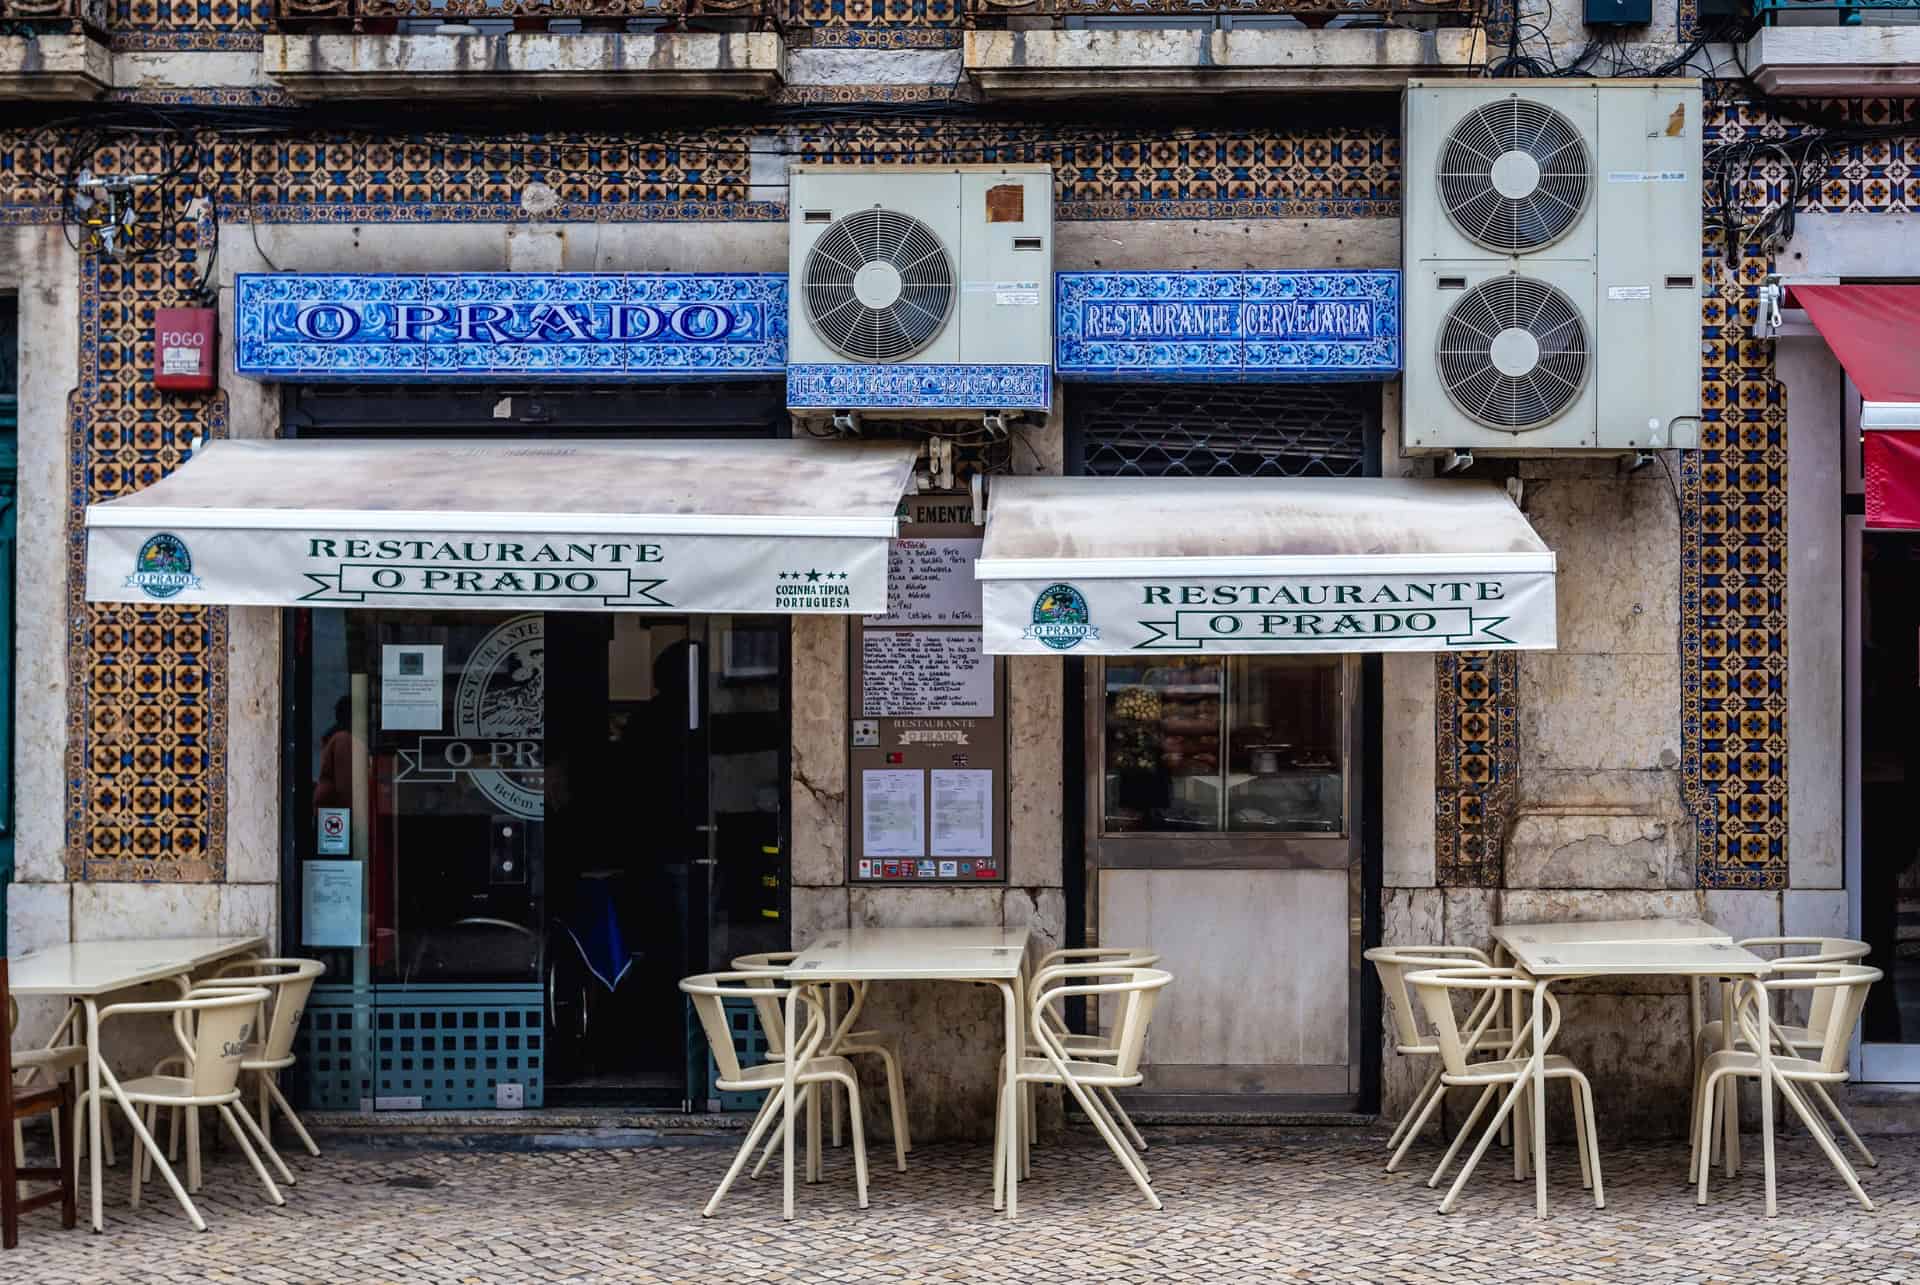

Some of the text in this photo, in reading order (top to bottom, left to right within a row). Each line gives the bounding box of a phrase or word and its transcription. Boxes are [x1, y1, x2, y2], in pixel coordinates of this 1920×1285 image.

[296, 303, 736, 344] O PRADO
[1087, 301, 1370, 336] RESTAURANTE CERVEJARIA
[162, 331, 204, 346] FOGO
[917, 504, 973, 523] EMENTA
[308, 538, 664, 563] RESTAURANTE
[137, 575, 189, 585] O PRADO
[372, 568, 598, 592] O PRADO
[776, 582, 850, 595] COZINHA TÍPICA
[776, 597, 850, 608] PORTUGUESA
[1142, 581, 1504, 605] RESTAURANTE
[1034, 625, 1087, 635] O PRADO
[1209, 612, 1436, 635] O PRADO
[462, 621, 540, 726] RESTAURANTE
[894, 719, 976, 728] RESTAURANTE
[444, 741, 473, 767] O
[493, 782, 533, 809] Belém
